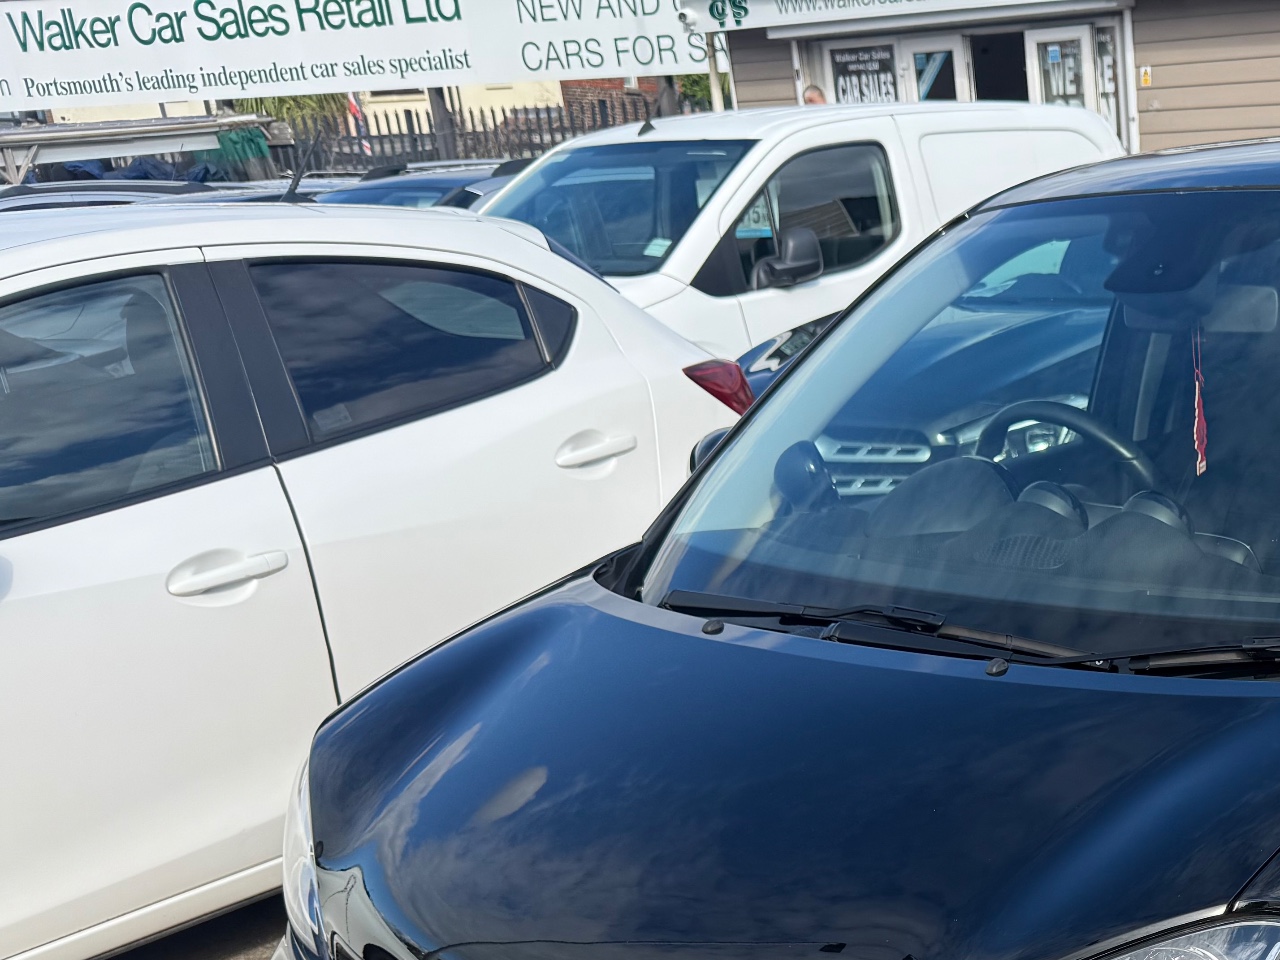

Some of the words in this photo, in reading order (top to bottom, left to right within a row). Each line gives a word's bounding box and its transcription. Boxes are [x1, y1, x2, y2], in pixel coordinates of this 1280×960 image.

[5, 8, 121, 52] Walker
[127, 2, 188, 46] Car
[193, 0, 290, 41] Sales
[297, 0, 394, 31] Retail
[516, 0, 584, 23] NEW
[596, 0, 661, 19] AND
[22, 72, 134, 97] Portsmouth’s
[134, 68, 198, 94] leading
[199, 61, 308, 91] independent
[310, 63, 338, 79] car
[343, 55, 386, 77] sales
[389, 48, 472, 79] specialist
[521, 37, 605, 72] CARS
[614, 34, 679, 67] FOR
